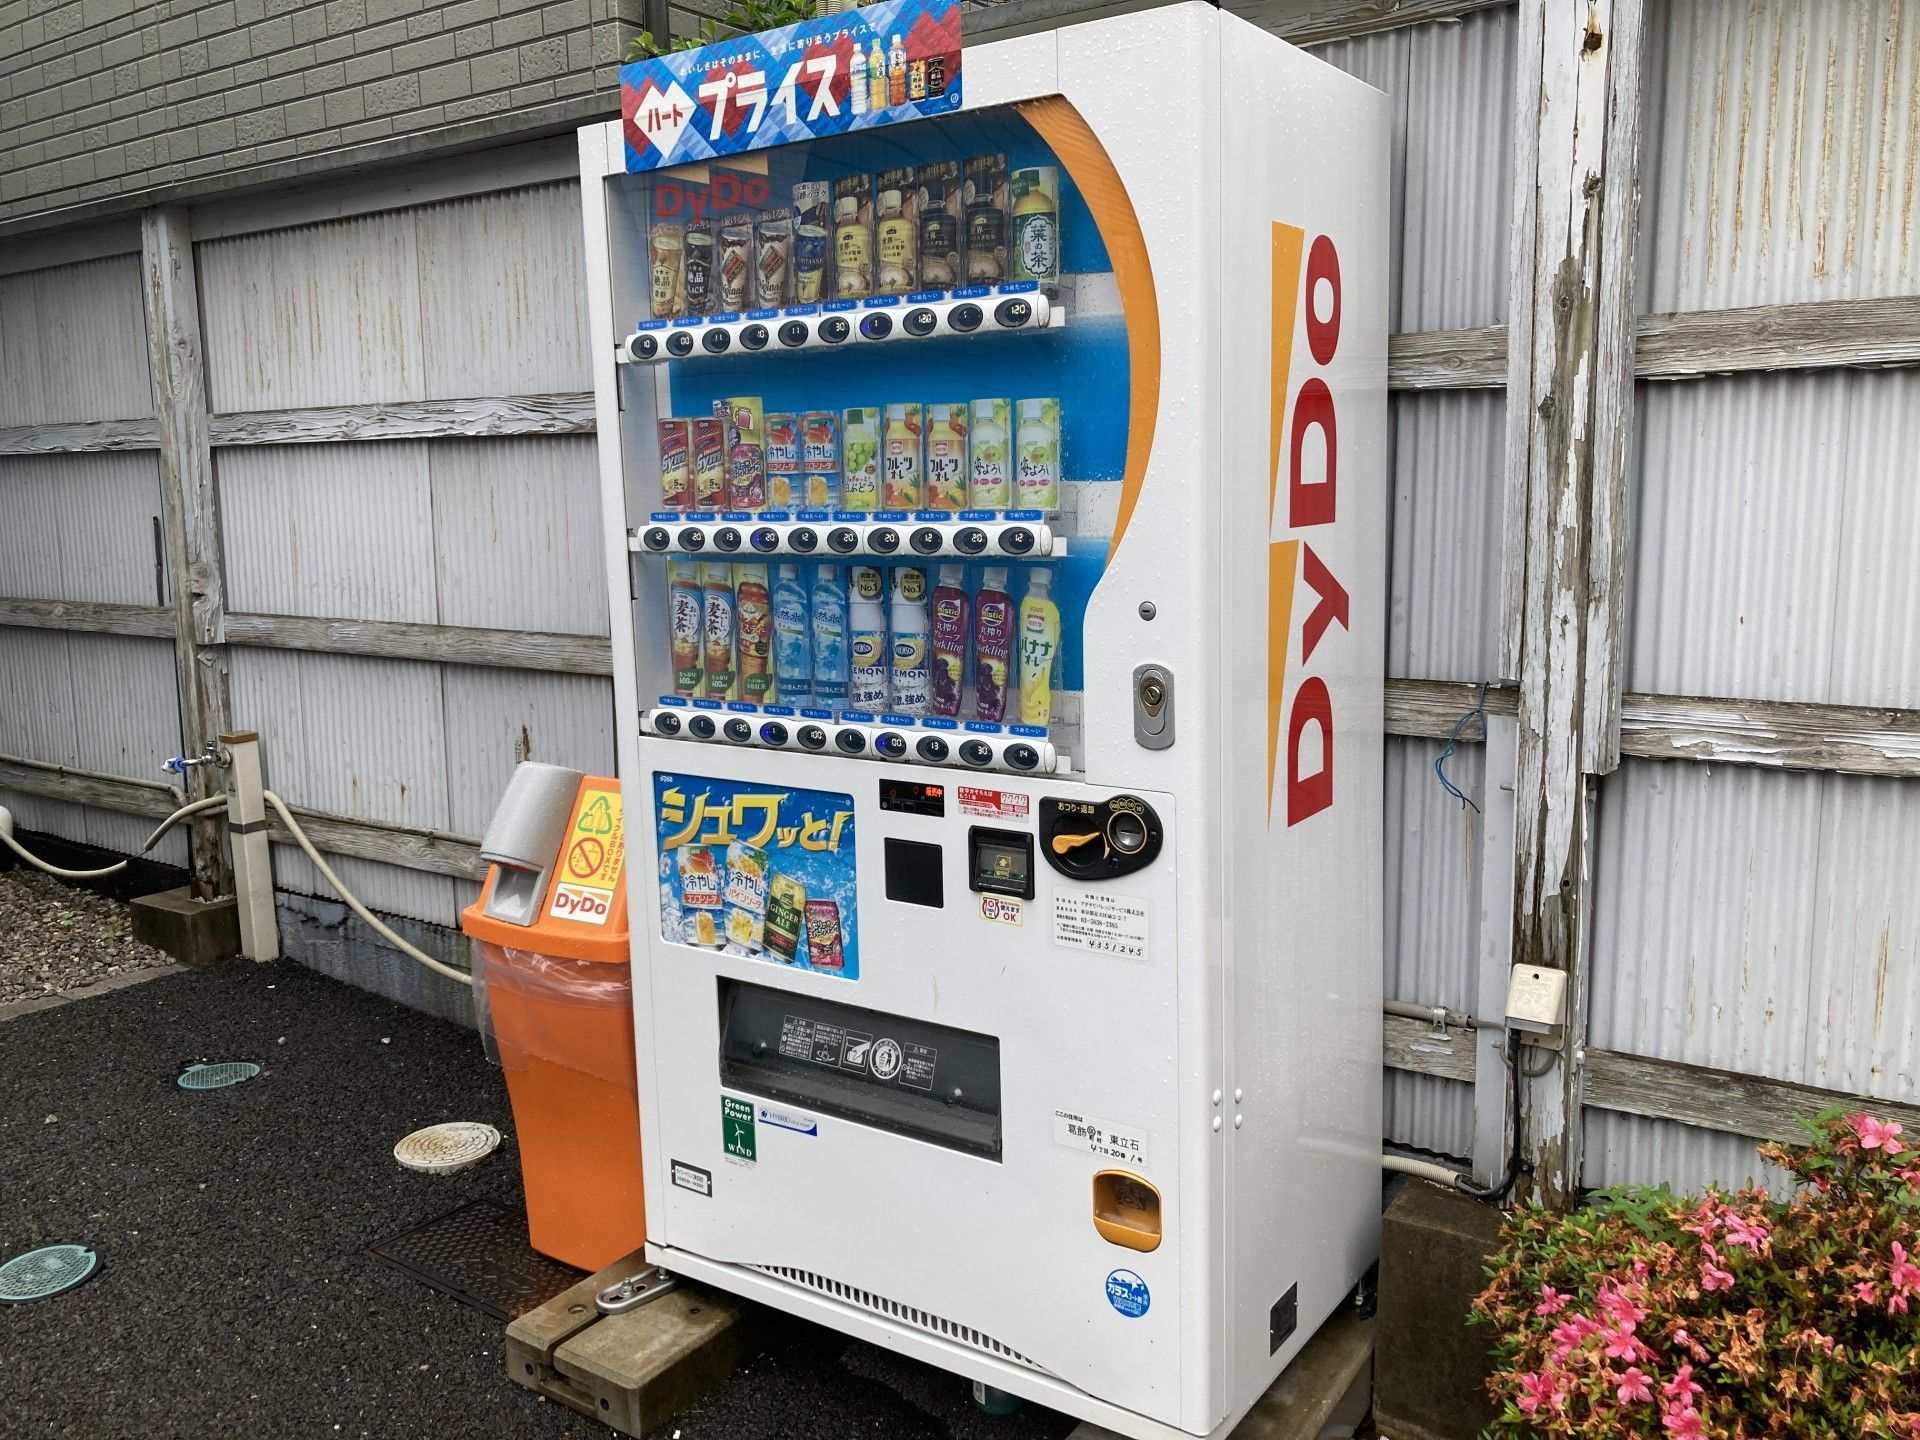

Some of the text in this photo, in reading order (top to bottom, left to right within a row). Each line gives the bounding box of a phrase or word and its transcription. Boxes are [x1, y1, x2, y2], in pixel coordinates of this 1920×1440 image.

[699, 54, 841, 141] プライス
[647, 101, 685, 134] ハート
[655, 174, 769, 225] DyDo
[1030, 224, 1048, 269] 葉の茶
[1004, 283, 1032, 292] つめた〜い
[766, 445, 795, 460] 冷やし
[804, 444, 832, 459] 冷やし
[887, 456, 913, 471] フルーツ
[930, 458, 959, 473] フルーツ
[860, 583, 878, 592] No.1
[903, 584, 921, 594] No.1
[675, 599, 690, 633] 麦茶
[707, 601, 722, 635] 麦茶
[853, 666, 885, 676] EMON
[970, 722, 996, 731] つめた〜い
[1014, 727, 1041, 735] つめた〜い
[685, 874, 716, 891] 冷やし
[730, 870, 763, 898] 冷やし
[554, 892, 607, 916] DyDo
[769, 903, 799, 925] GINGER
[1003, 912, 1017, 922] OK
[775, 916, 791, 930] ALE
[724, 1098, 751, 1113] Green
[724, 1106, 752, 1122] Power
[727, 1143, 752, 1157] WIND
[1109, 1134, 1140, 1151] 東立石
[1107, 1282, 1129, 1299] ガラス
